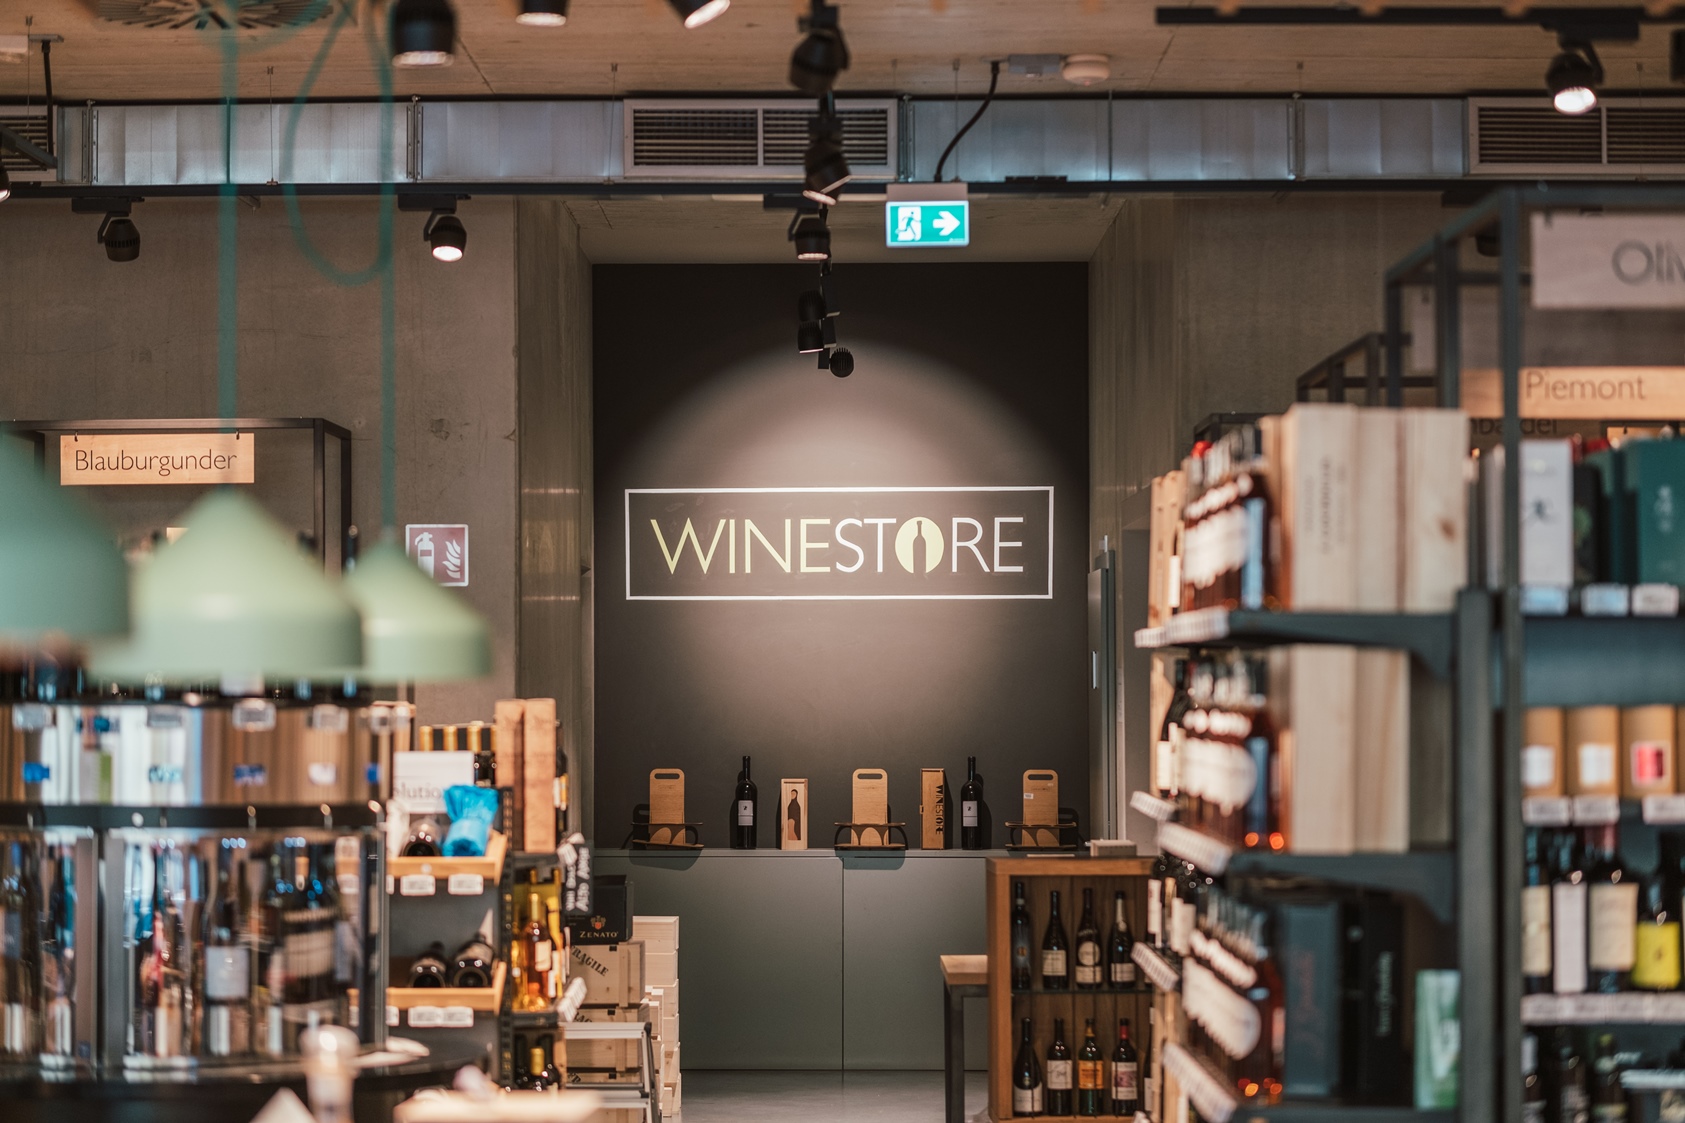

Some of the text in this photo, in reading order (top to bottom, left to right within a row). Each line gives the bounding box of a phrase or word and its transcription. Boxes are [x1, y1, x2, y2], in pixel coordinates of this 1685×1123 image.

[1525, 370, 1646, 401] Piemont
[75, 449, 237, 477] Blauburgunder
[650, 516, 1024, 574] WINESTORE
[936, 784, 944, 835] WINESTORE
